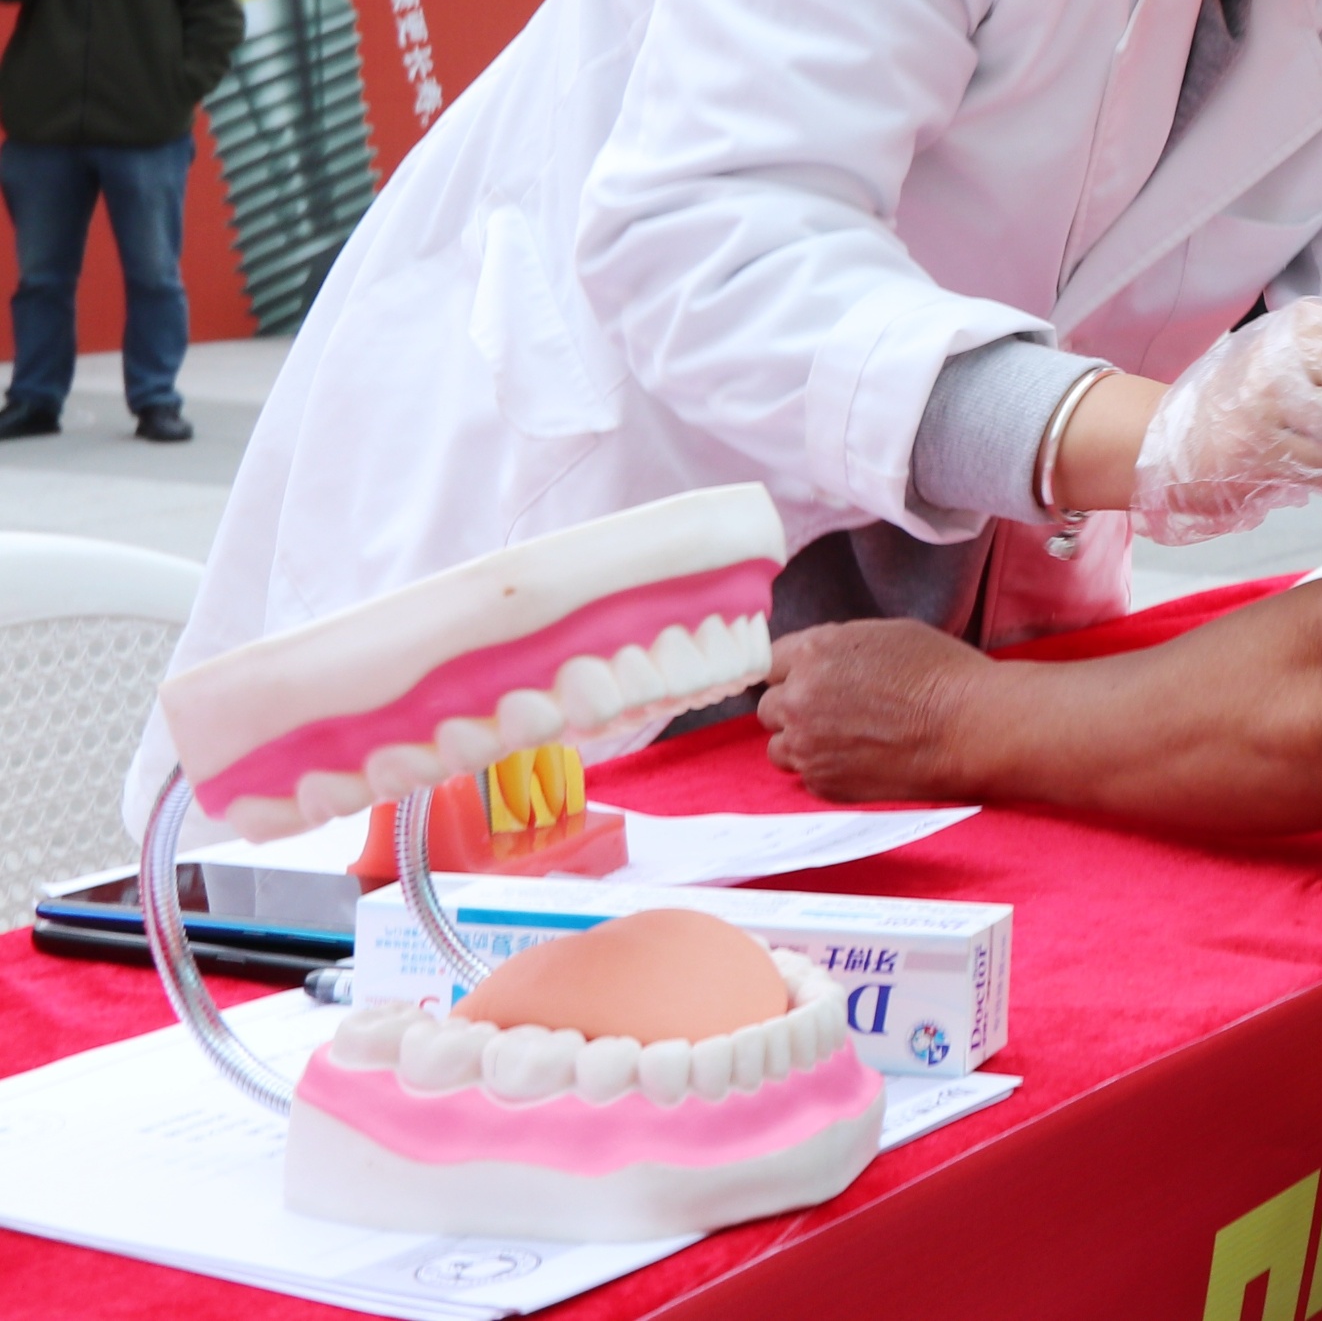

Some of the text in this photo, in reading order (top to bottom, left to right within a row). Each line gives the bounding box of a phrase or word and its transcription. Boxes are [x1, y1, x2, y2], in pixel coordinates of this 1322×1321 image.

[821, 943, 899, 975] 牙博士
[969, 944, 989, 1052] Doctor
